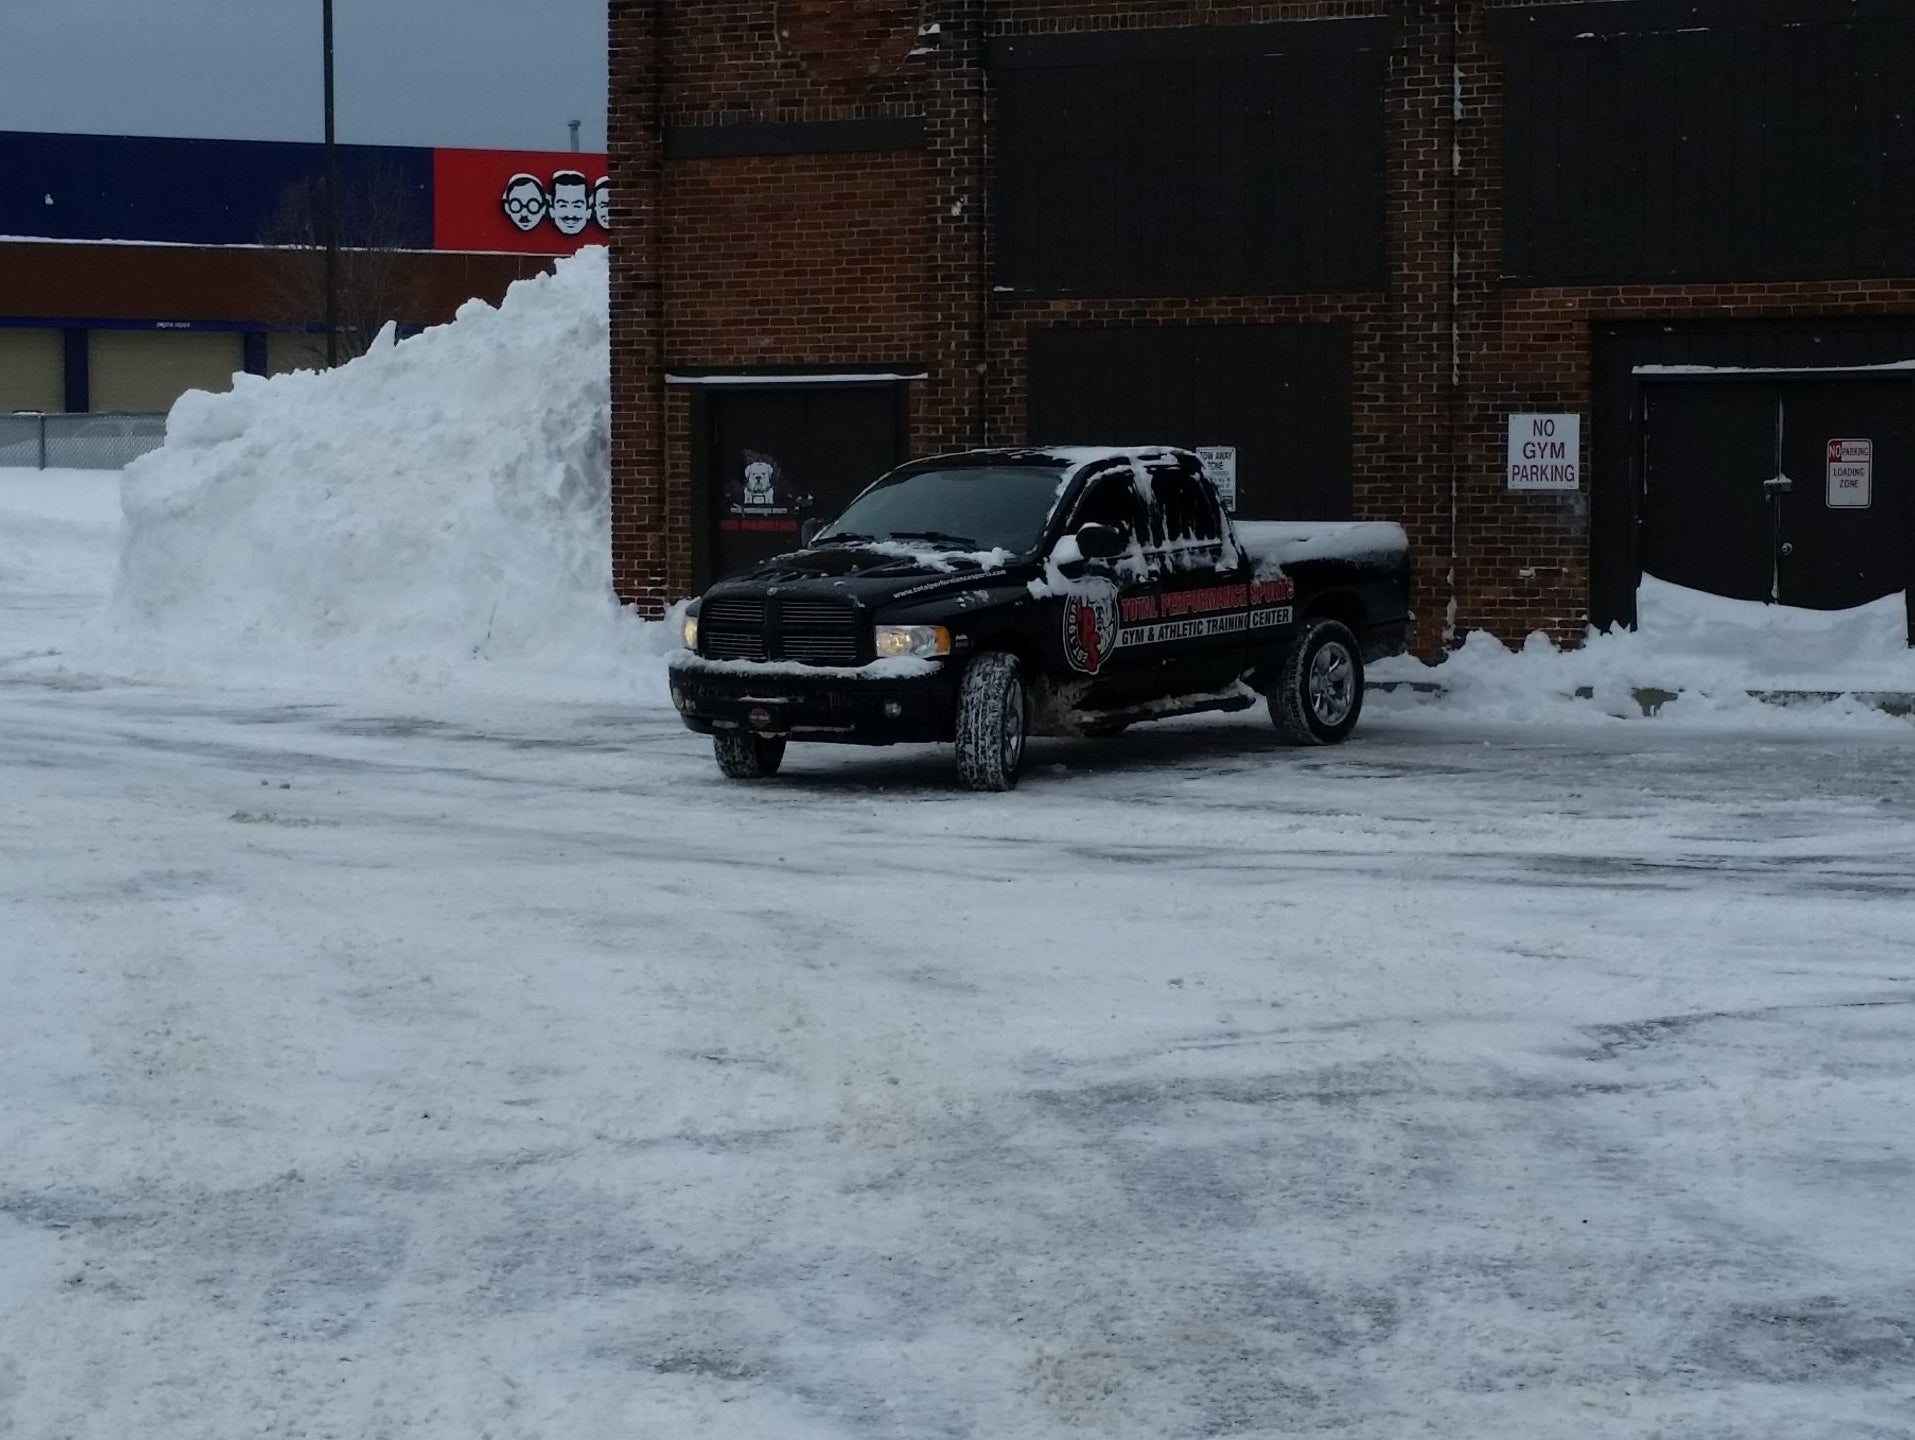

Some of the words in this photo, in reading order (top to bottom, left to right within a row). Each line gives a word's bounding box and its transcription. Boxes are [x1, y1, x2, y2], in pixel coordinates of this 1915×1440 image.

[1533, 419, 1555, 437] NO
[1523, 441, 1565, 459] GYM
[1829, 444, 1841, 458] NO
[1512, 464, 1575, 482] PARKING
[1833, 467, 1865, 477] LOADING
[1839, 479, 1859, 488] ZONE
[1121, 596, 1159, 622] TOTAL
[1160, 585, 1248, 617] PERFORMANCE
[1121, 626, 1145, 645] GYM
[1147, 628, 1155, 642] &
[1157, 619, 1204, 640] ATHLETIC
[1206, 613, 1249, 634] TRAINING
[1252, 608, 1290, 627] CENTER
